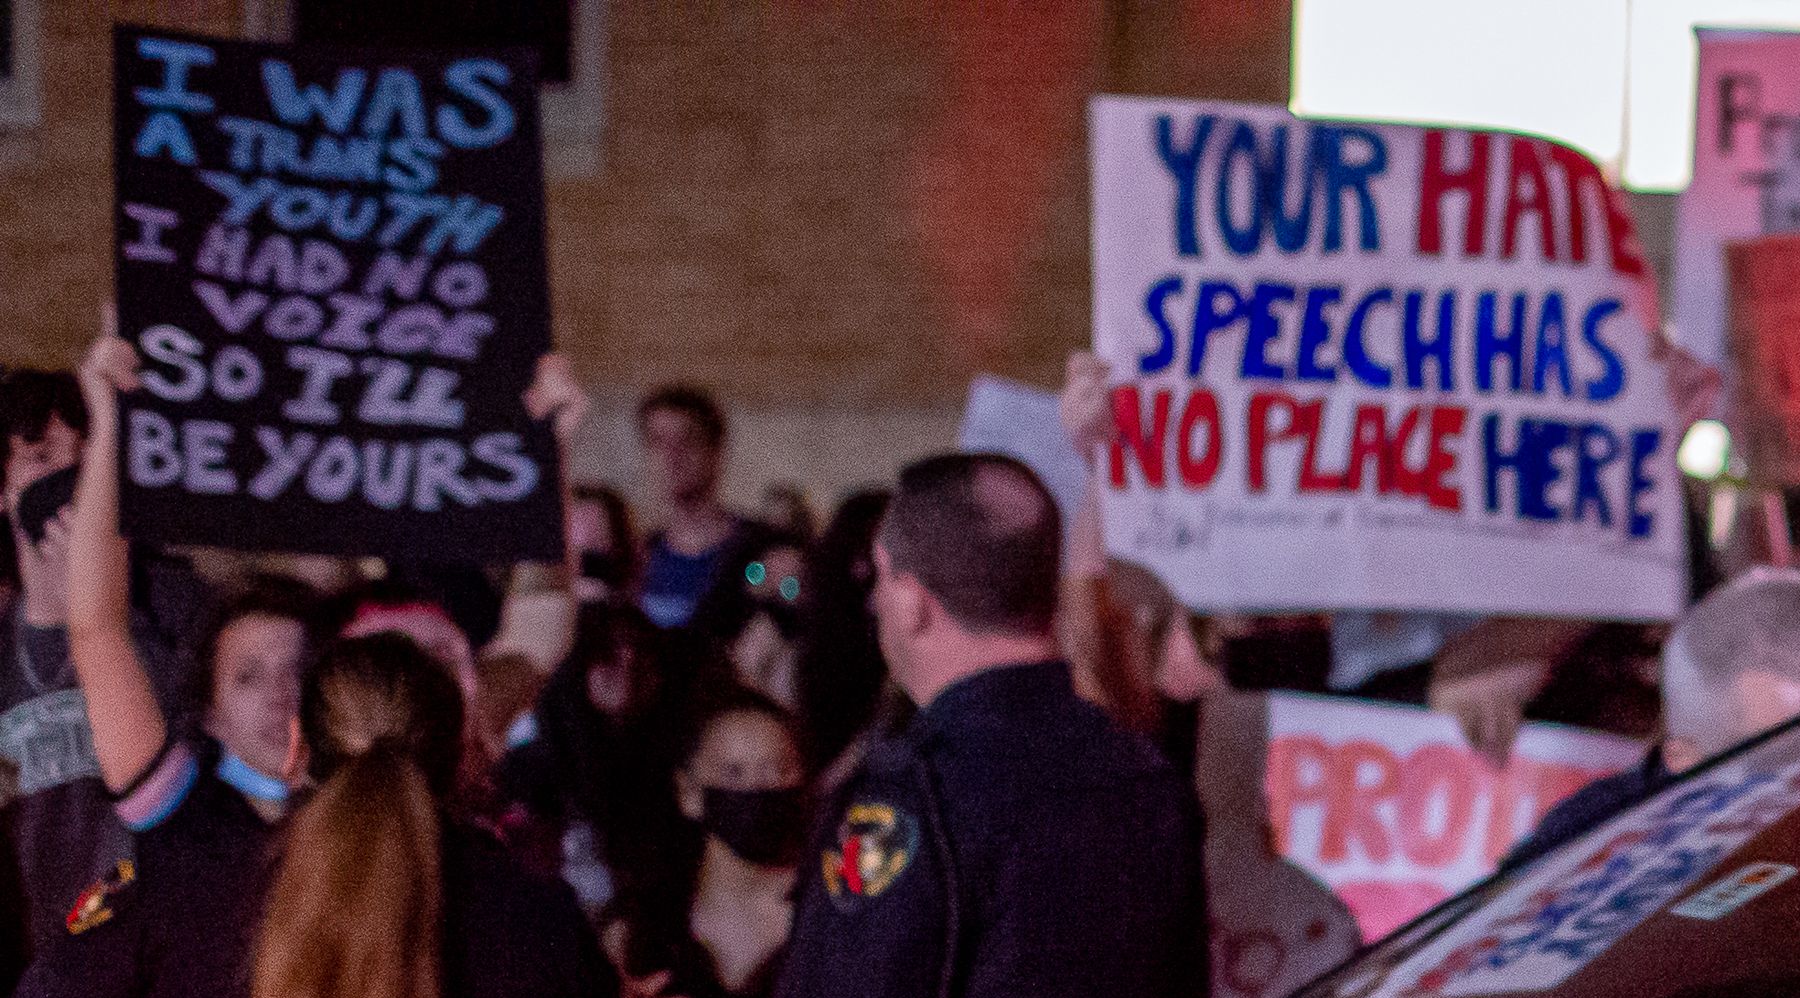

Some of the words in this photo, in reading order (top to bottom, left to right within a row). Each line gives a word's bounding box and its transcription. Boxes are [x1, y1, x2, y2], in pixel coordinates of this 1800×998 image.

[136, 37, 216, 112] I
[261, 58, 516, 149] WAS
[134, 111, 198, 164] A
[216, 115, 445, 193] TRANS
[1155, 112, 1389, 257] YOUR
[1416, 127, 1643, 276] HATE
[122, 203, 180, 264] I
[197, 221, 350, 294] HAD
[362, 250, 490, 308] NO
[200, 168, 505, 255] YOUTH
[138, 323, 265, 401] SO
[191, 280, 497, 361] VOICE
[1139, 275, 1457, 393] SPEECH
[1475, 290, 1626, 402] HAS
[127, 408, 239, 496] BE
[247, 430, 541, 512] YOURS
[1107, 386, 1222, 490] NO
[1247, 391, 1470, 511] PLACE
[1482, 412, 1661, 538] HERE
